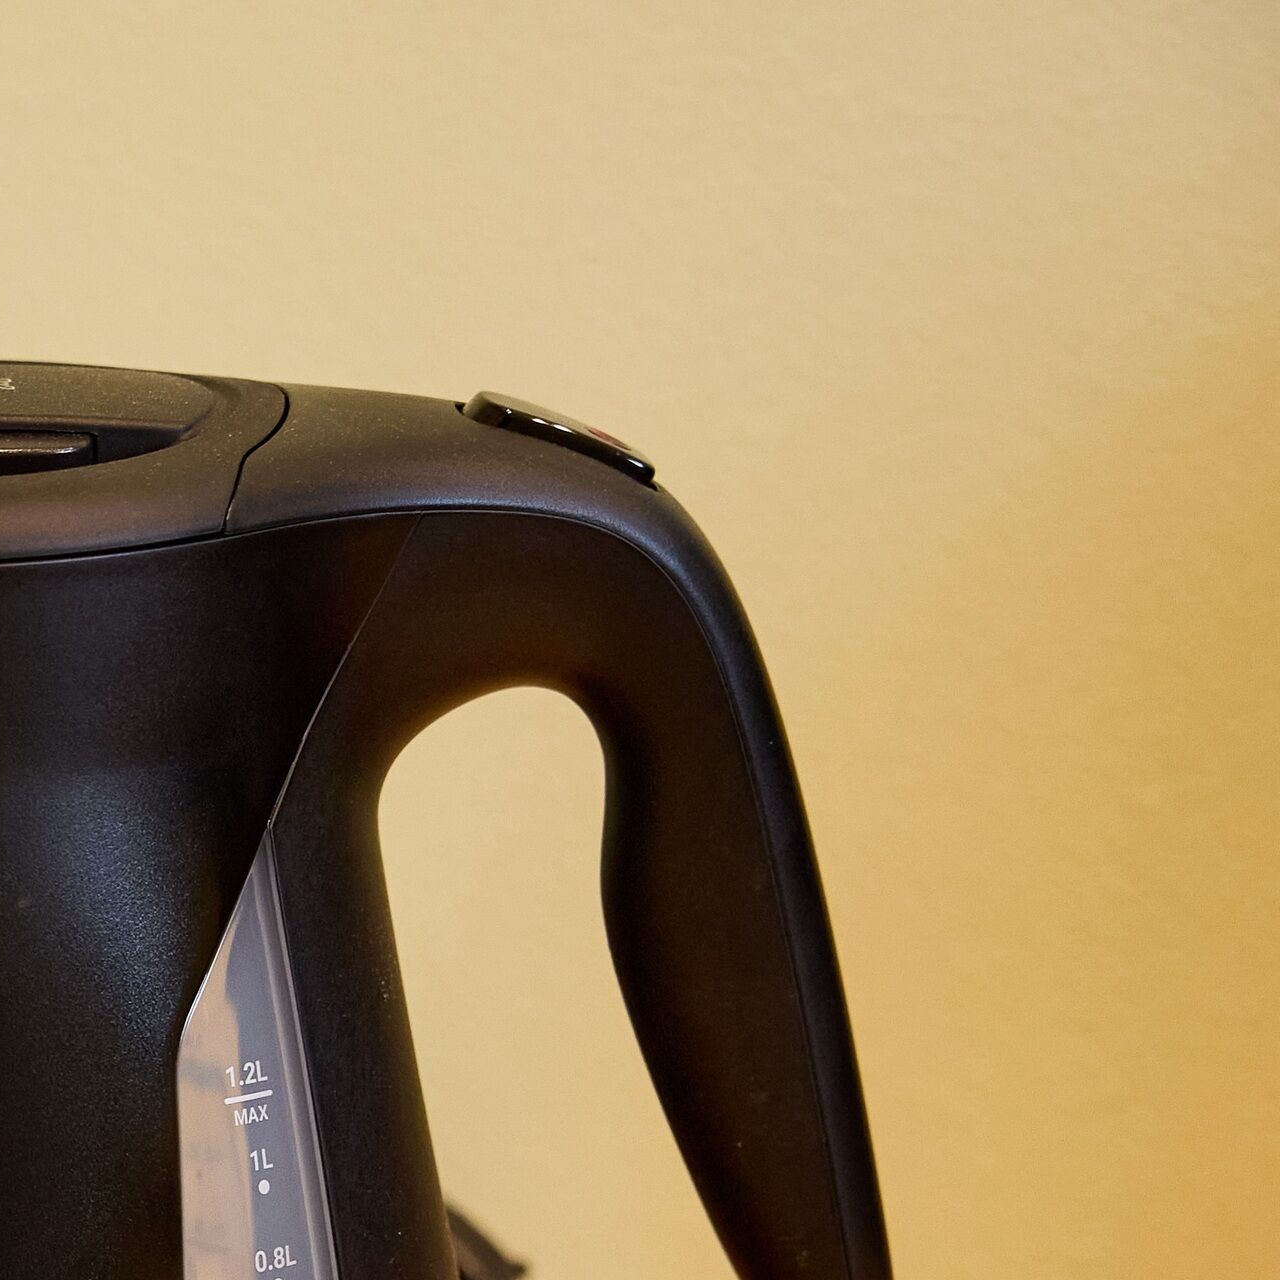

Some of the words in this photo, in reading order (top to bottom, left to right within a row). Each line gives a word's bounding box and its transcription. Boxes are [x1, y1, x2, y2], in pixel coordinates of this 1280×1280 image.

[225, 1060, 268, 1088] 1.2L
[234, 1105, 269, 1126] MAX
[249, 1148, 274, 1171] 1L
[254, 1245, 297, 1273] 0.8L
